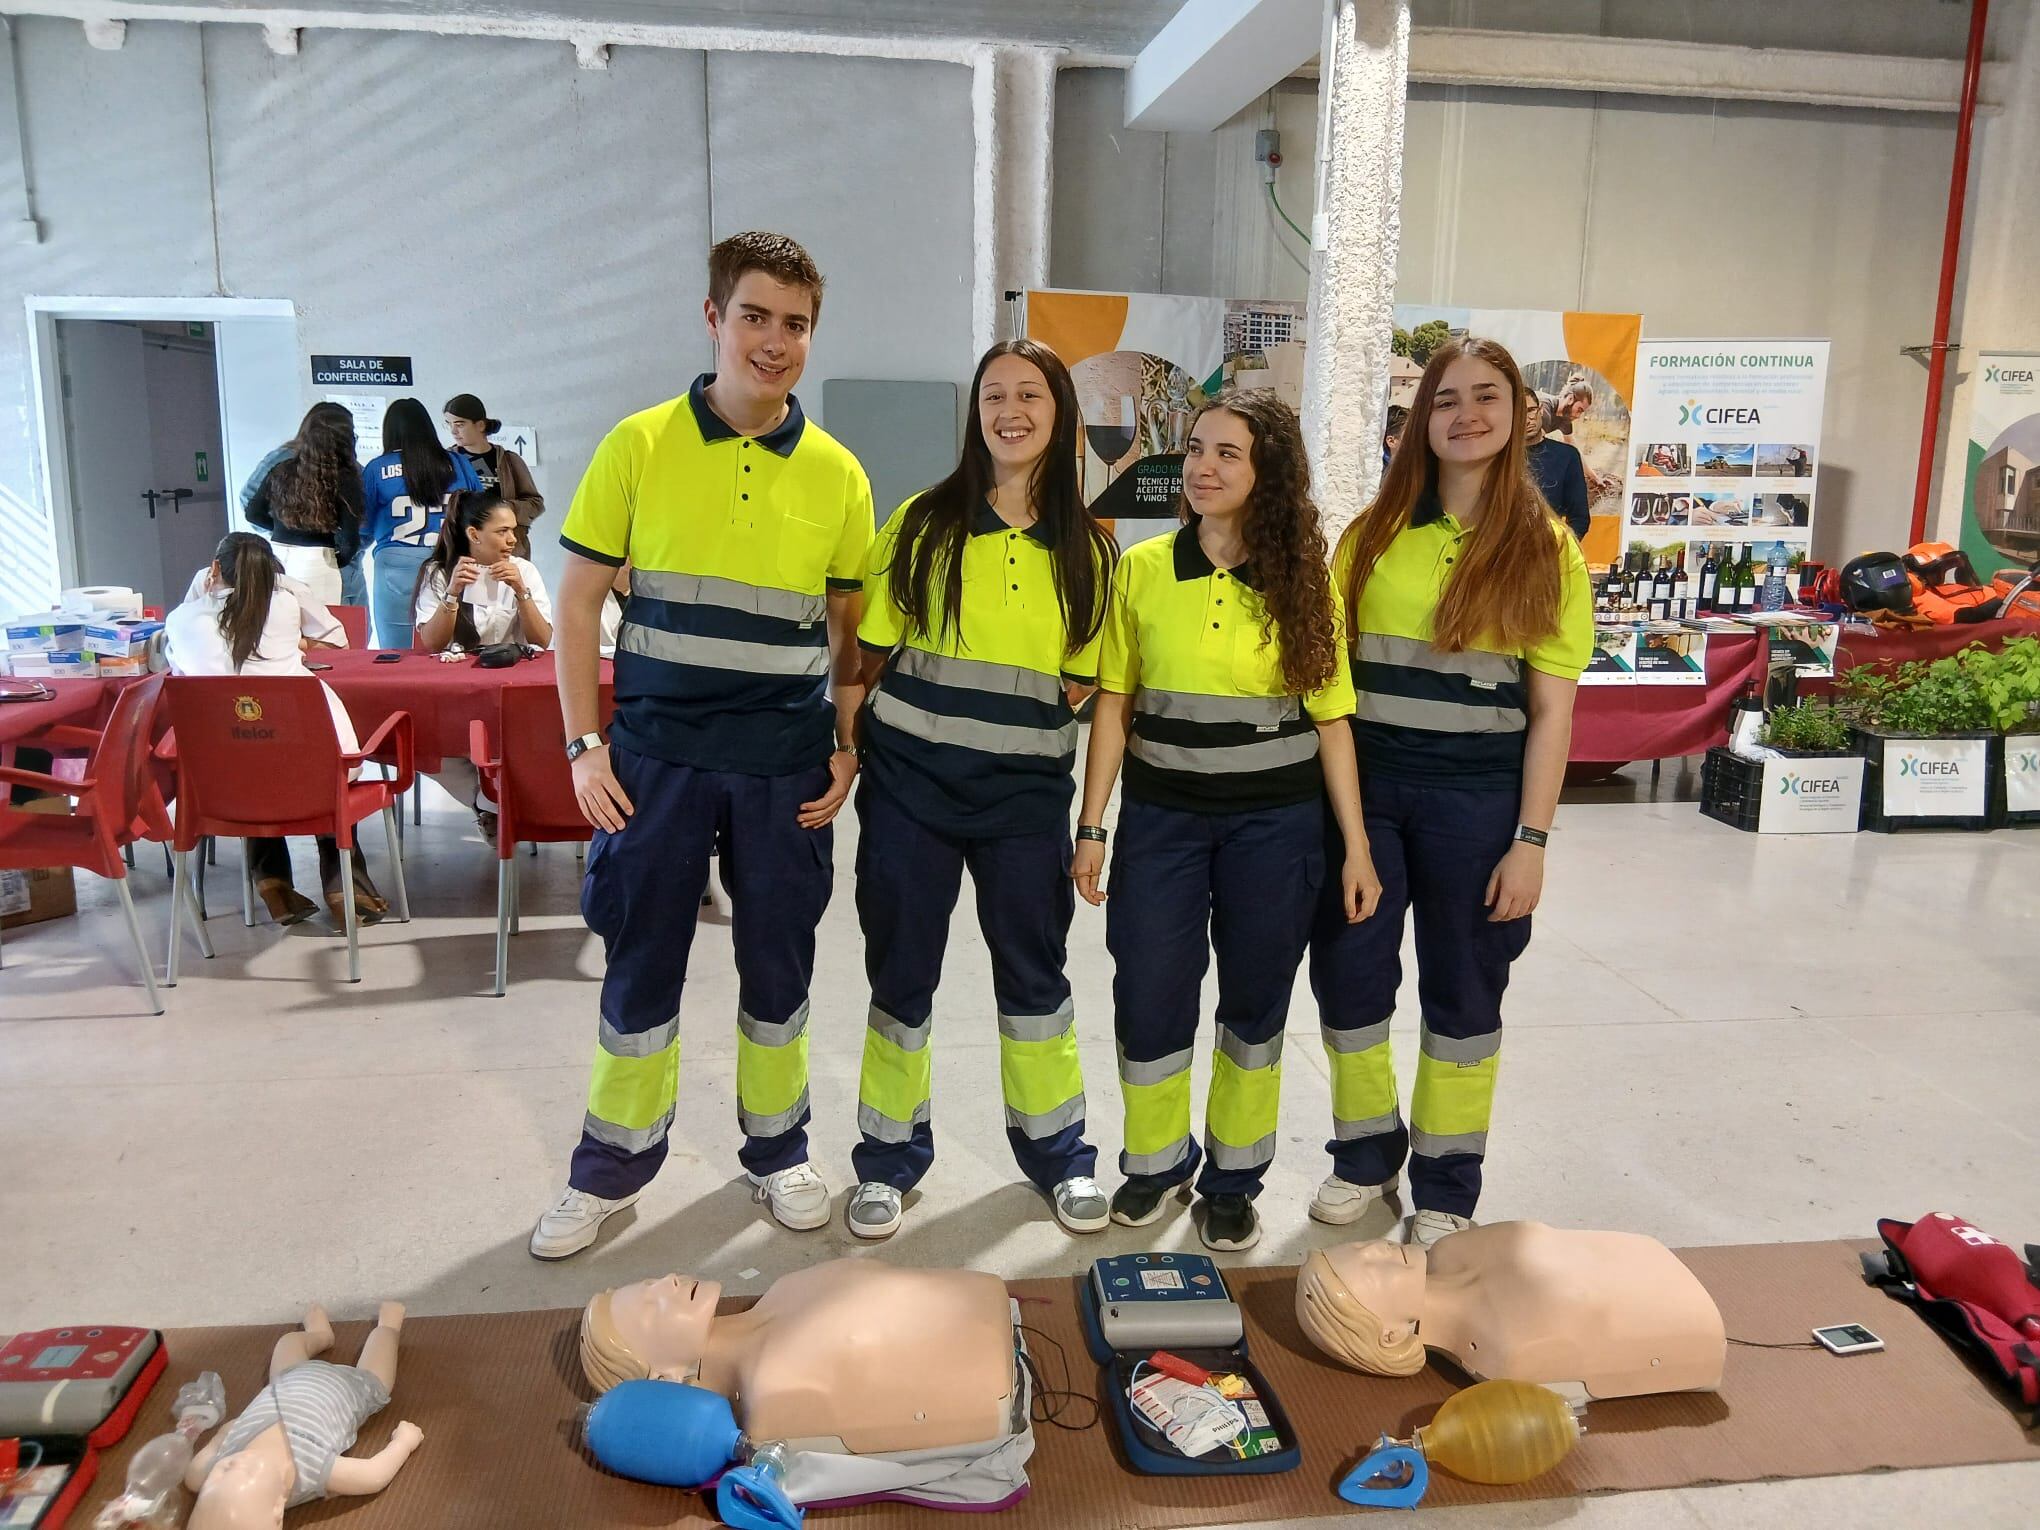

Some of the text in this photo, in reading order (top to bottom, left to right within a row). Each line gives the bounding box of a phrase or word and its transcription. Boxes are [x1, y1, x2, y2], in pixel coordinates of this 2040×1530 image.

[339, 359, 384, 370] SALA DE
[1650, 353, 1814, 367] FORMACIÓN CONTINUA
[317, 372, 408, 383] CONFERENCIAS A
[2001, 370, 2034, 382] CIFEA
[1706, 408, 1761, 424] CIFEA
[381, 463, 403, 480] LOS
[1137, 464, 1168, 474] GRADO
[1137, 477, 1183, 486] TÉCNICO EN
[1136, 486, 1182, 494] ACEITES DE
[1135, 494, 1168, 502] Y VINOS
[1920, 761, 1960, 775] CIFEA
[1801, 779, 1840, 793] CIFEA
[1212, 1418, 1239, 1432] PHILIPS
